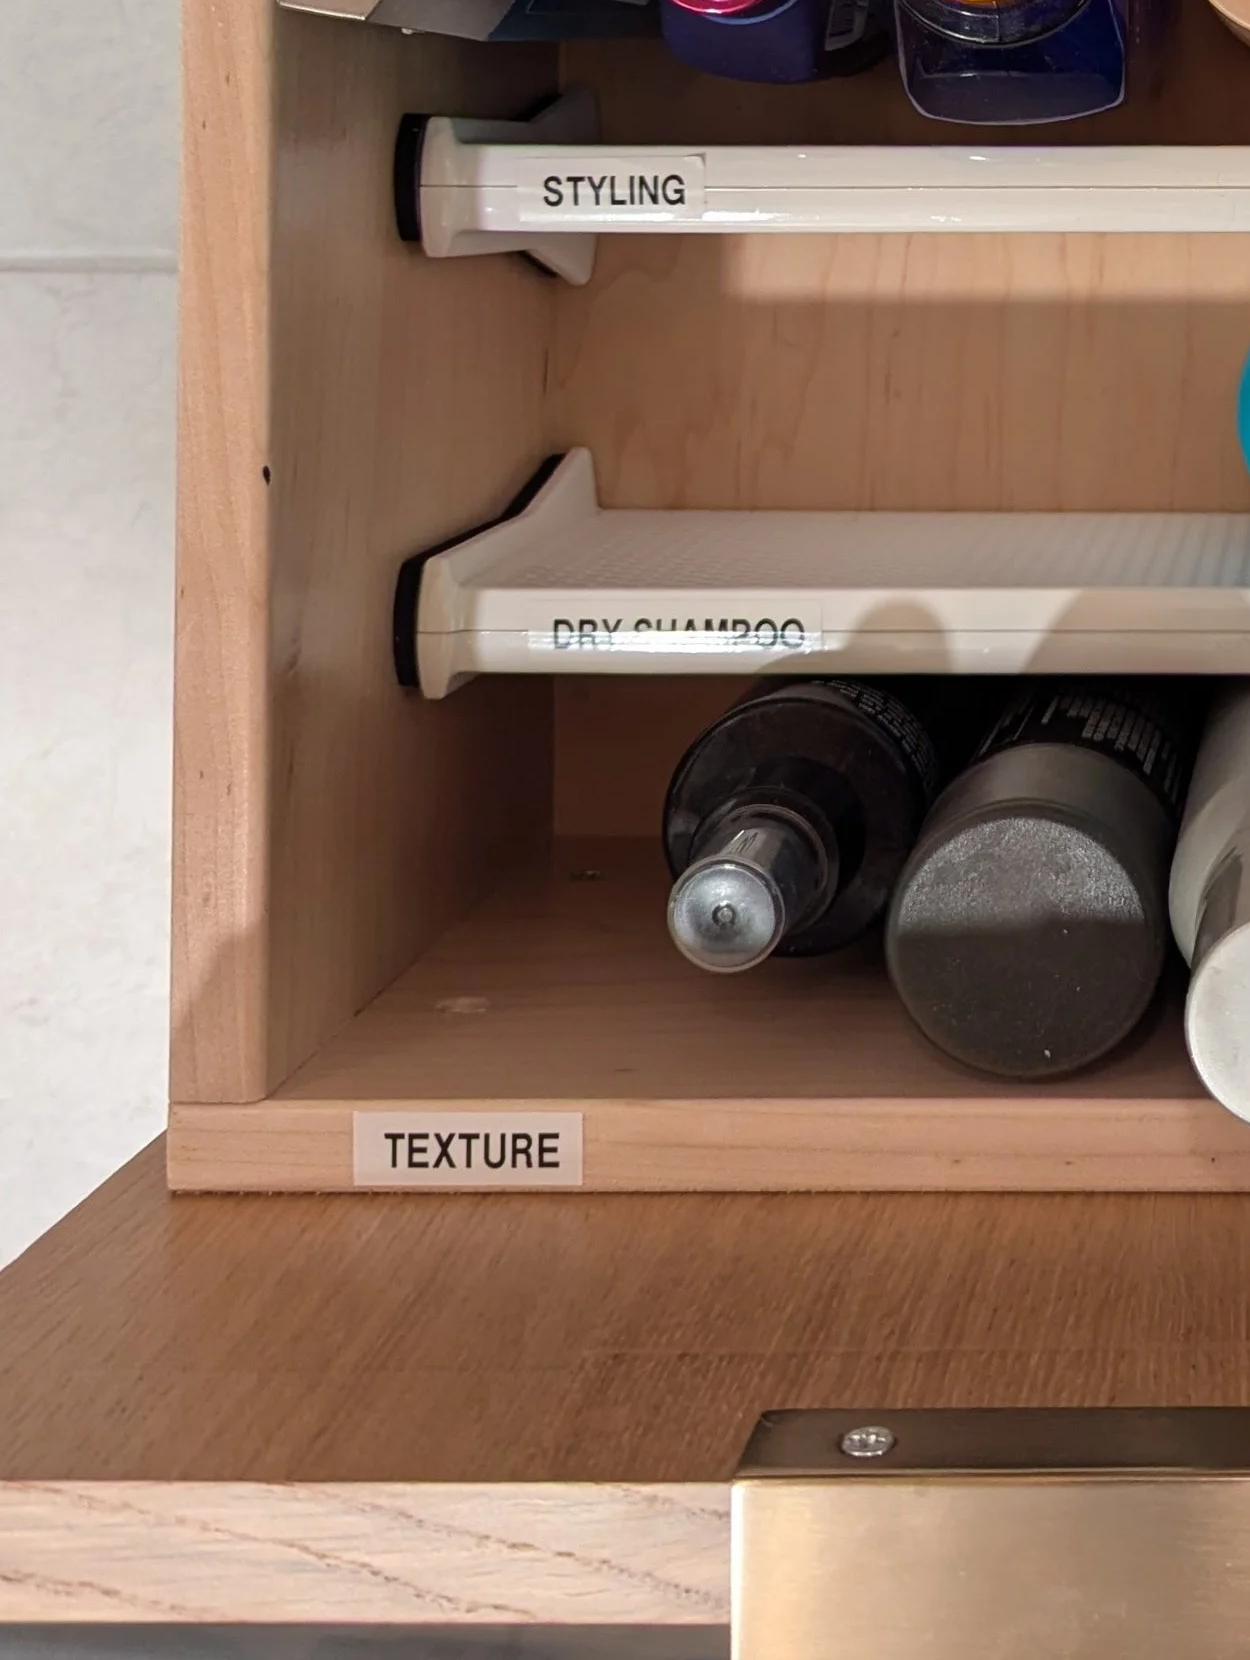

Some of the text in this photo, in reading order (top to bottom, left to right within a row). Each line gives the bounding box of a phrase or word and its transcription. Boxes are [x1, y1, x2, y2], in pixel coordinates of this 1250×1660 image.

[542, 172, 687, 208] STYLING
[552, 617, 624, 650] DRY
[383, 1131, 561, 1169] TEXTURE
